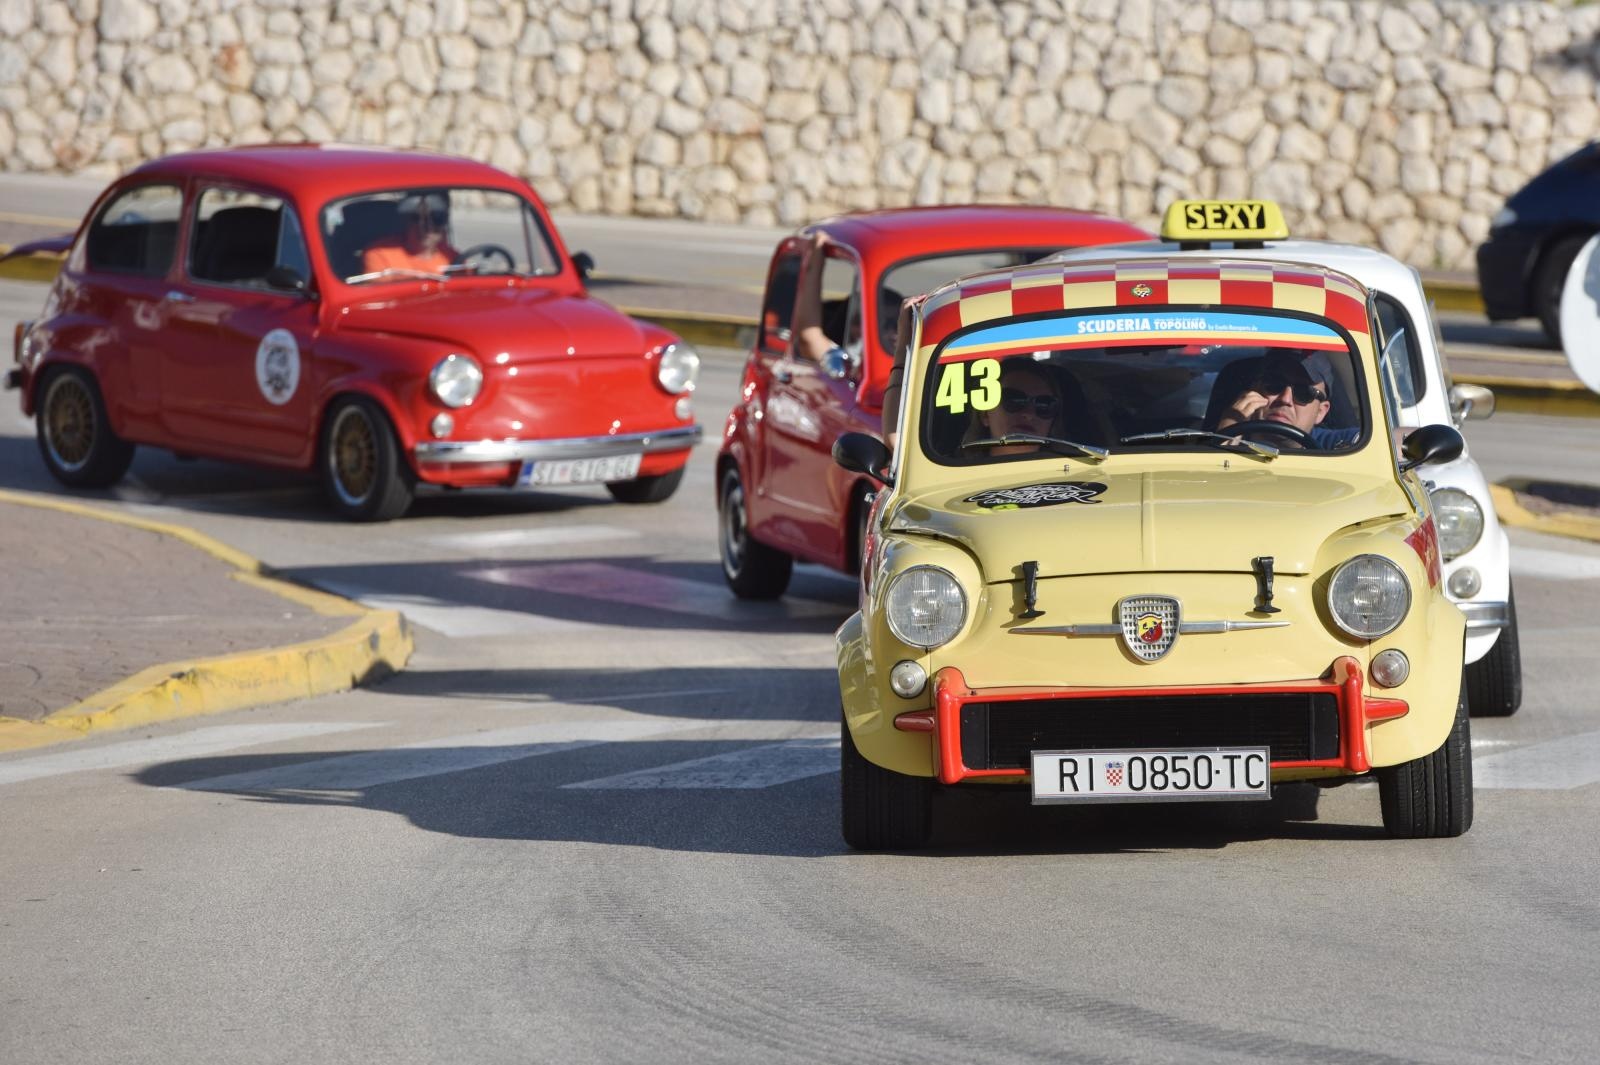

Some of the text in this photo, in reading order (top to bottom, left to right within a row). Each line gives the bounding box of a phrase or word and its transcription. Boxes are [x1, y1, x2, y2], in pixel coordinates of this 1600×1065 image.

[1185, 204, 1263, 230] SEXY
[1077, 318, 1151, 334] SCUDERIA
[1154, 320, 1207, 331] TOPOLINO
[935, 358, 1002, 414] 43
[1059, 757, 1095, 792] RI
